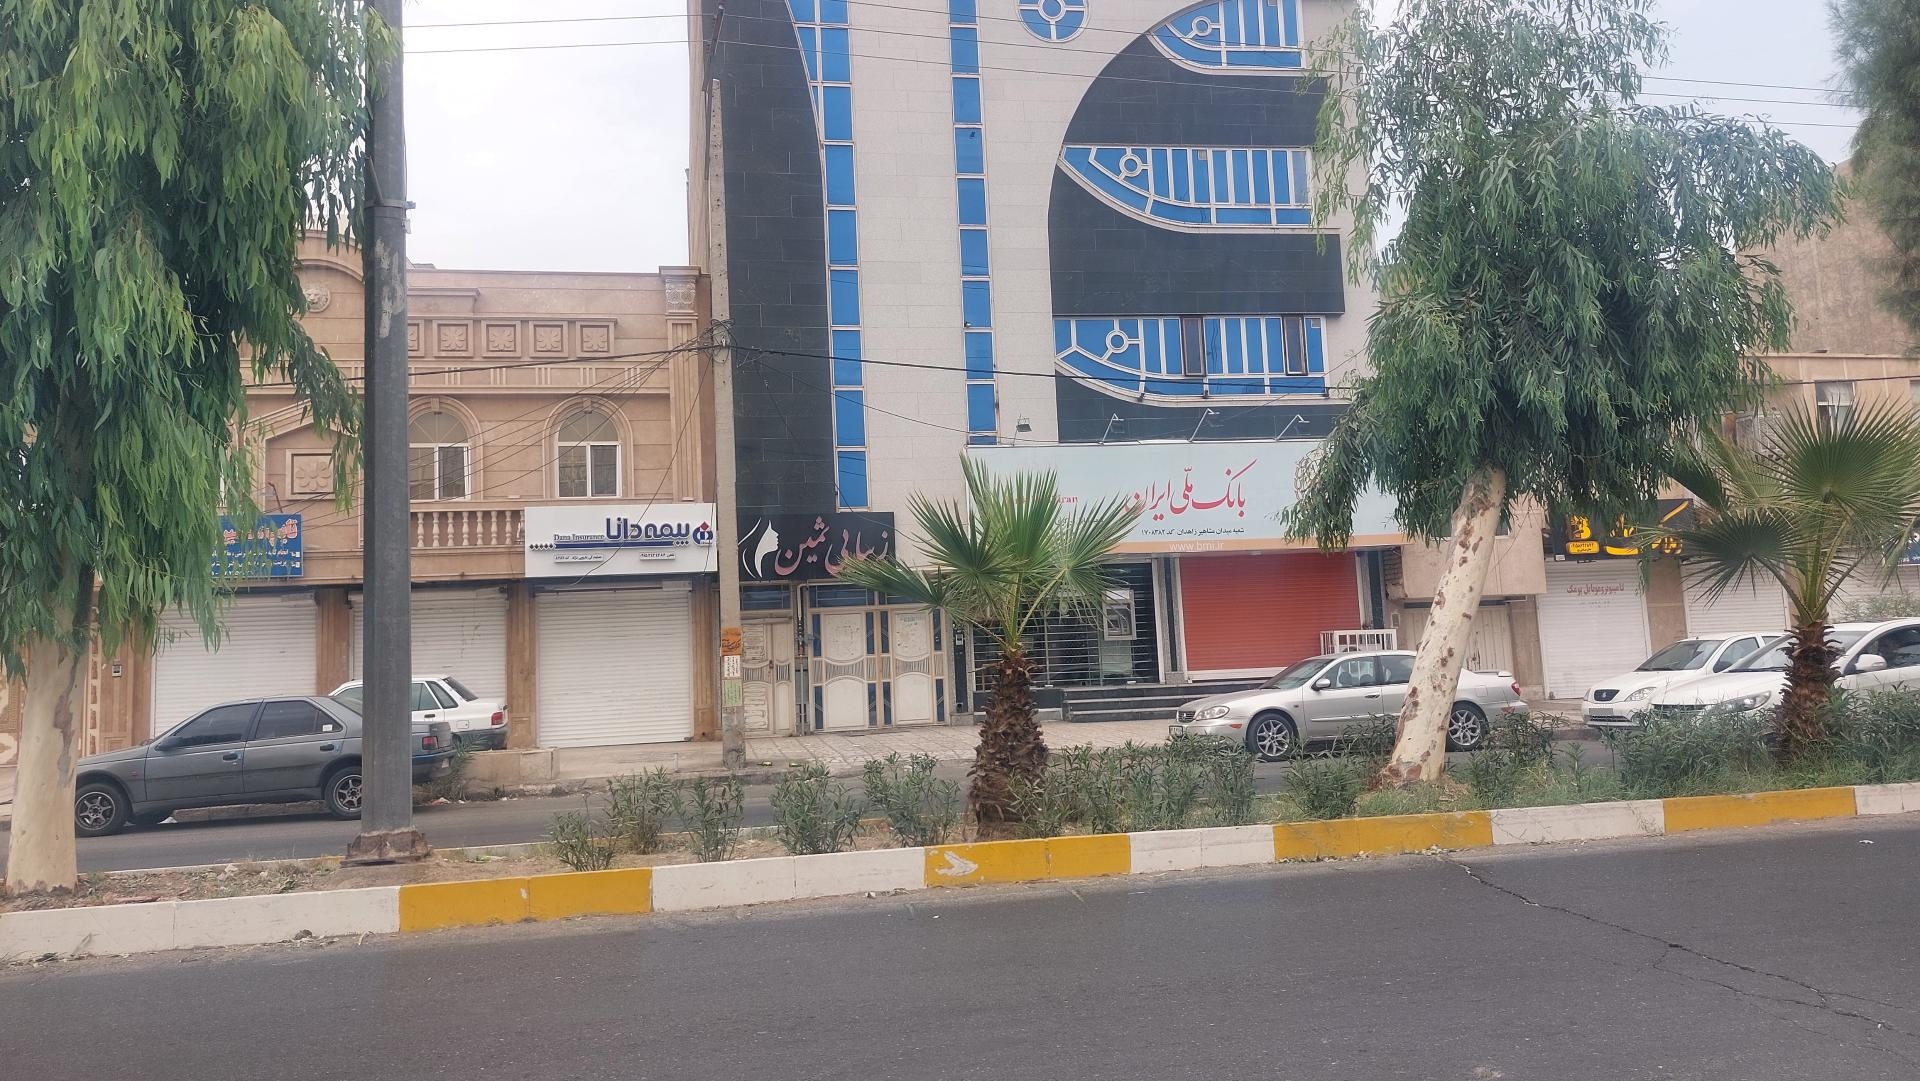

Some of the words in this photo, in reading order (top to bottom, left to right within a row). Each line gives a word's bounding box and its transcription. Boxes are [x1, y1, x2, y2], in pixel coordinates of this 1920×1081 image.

[1123, 478, 1171, 521] ایران
[1191, 458, 1258, 518] بانک
[554, 533, 571, 541] Dana
[572, 533, 606, 541] Insurance
[605, 515, 643, 541] دانا
[644, 522, 690, 545] بیمه
[774, 515, 830, 576] ثمین
[1168, 540, 1225, 551] www.bmi.ir
